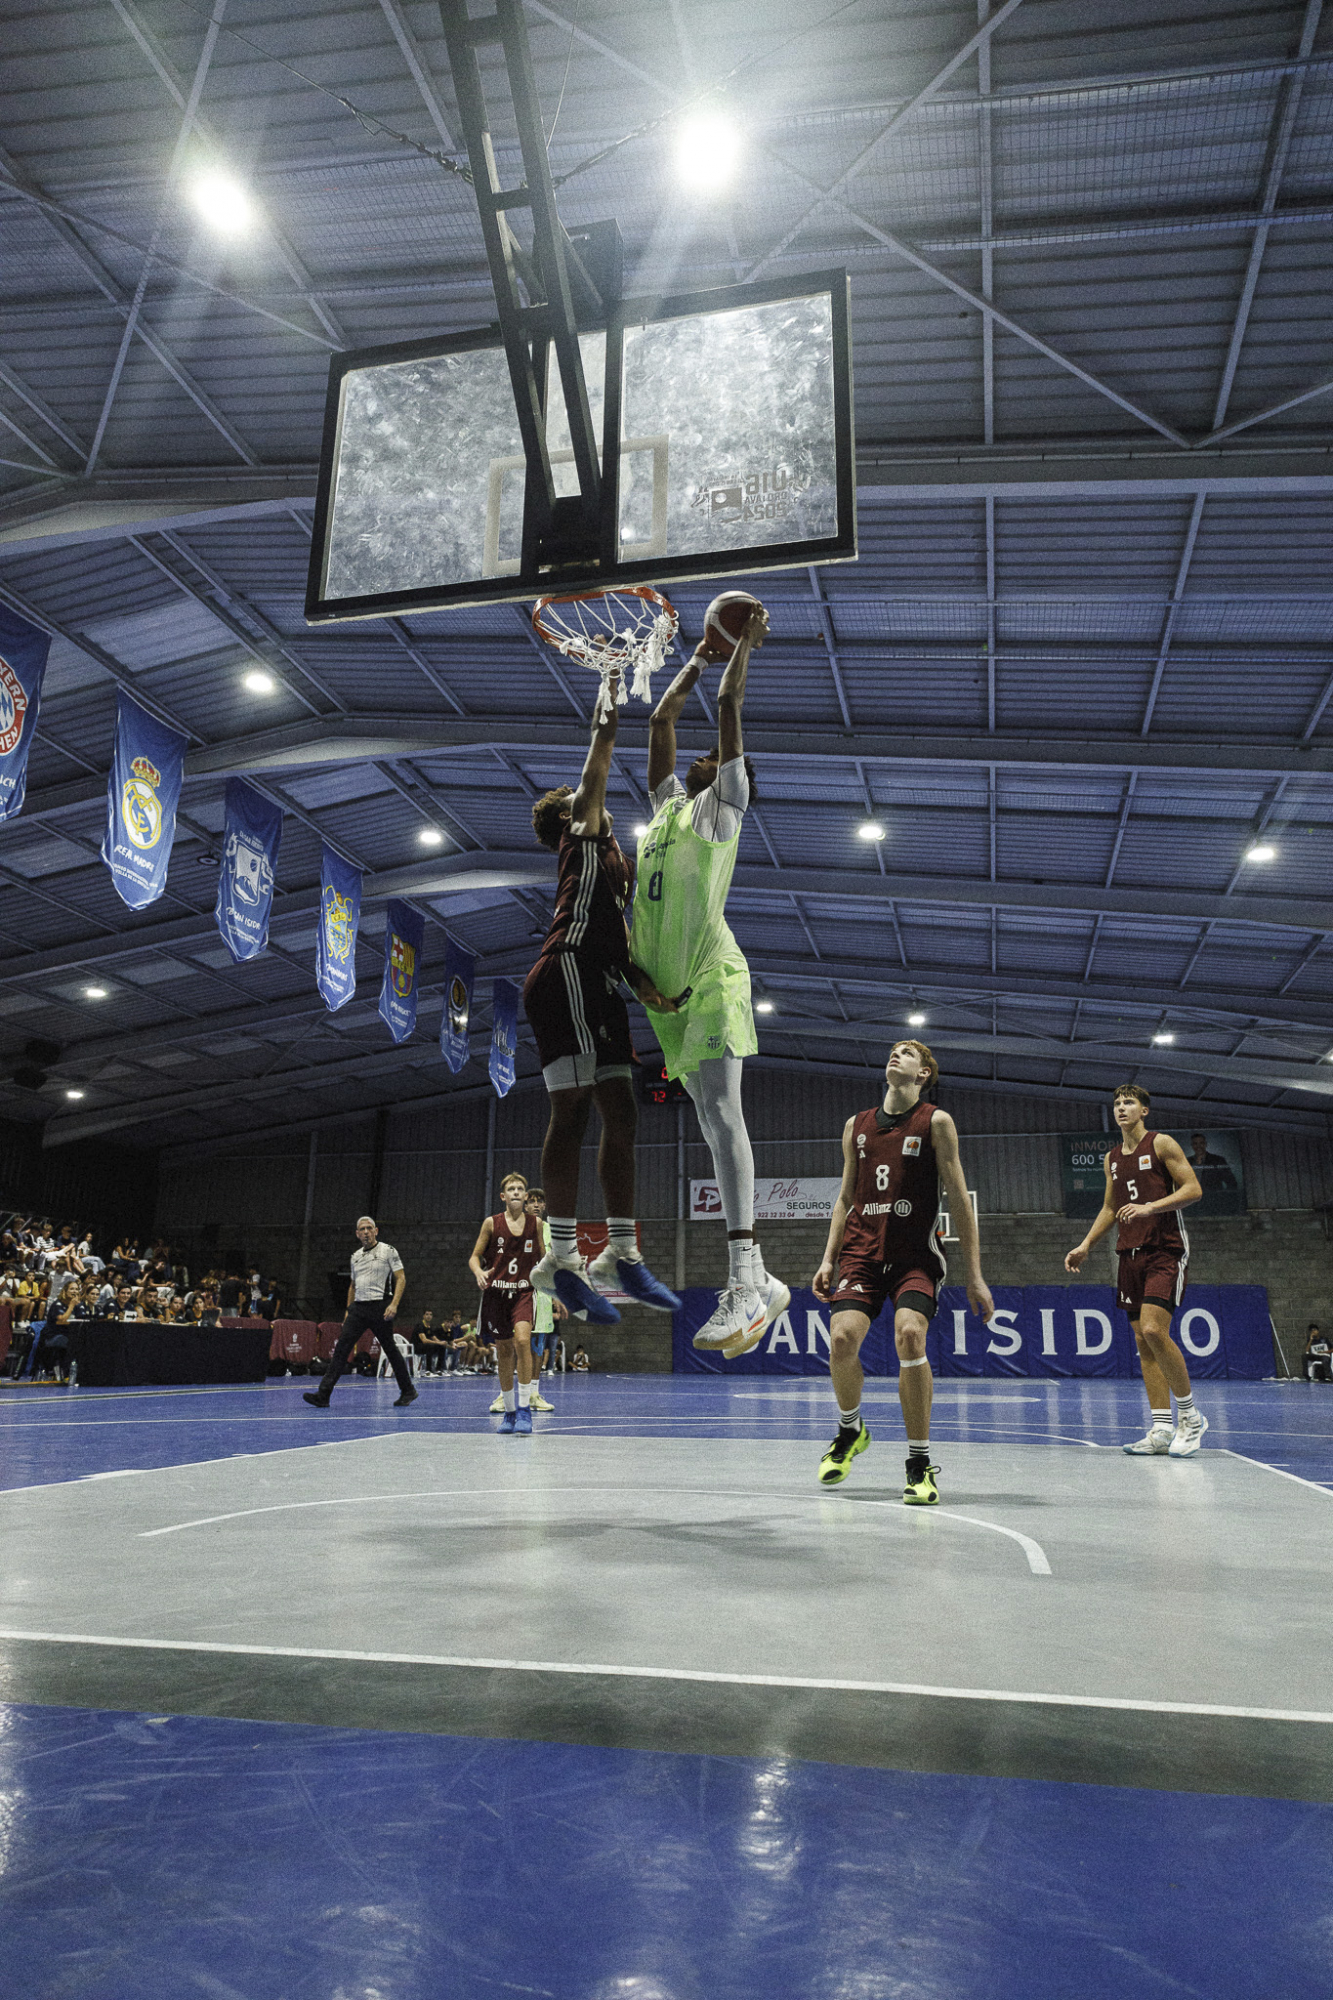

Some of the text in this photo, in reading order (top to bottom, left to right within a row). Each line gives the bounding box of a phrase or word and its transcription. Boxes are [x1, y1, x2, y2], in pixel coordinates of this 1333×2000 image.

[0, 660, 27, 712] YERN
[0, 726, 18, 750] HEN
[1071, 1154, 1095, 1165] 600
[875, 1164, 890, 1191] 8
[767, 1179, 799, 1202] Polo
[1126, 1179, 1139, 1201] 5
[786, 1201, 831, 1210] SEGUROS
[861, 1202, 892, 1216] Allianz
[508, 1257, 518, 1275] 6
[951, 1307, 1221, 1357] ISIDO
